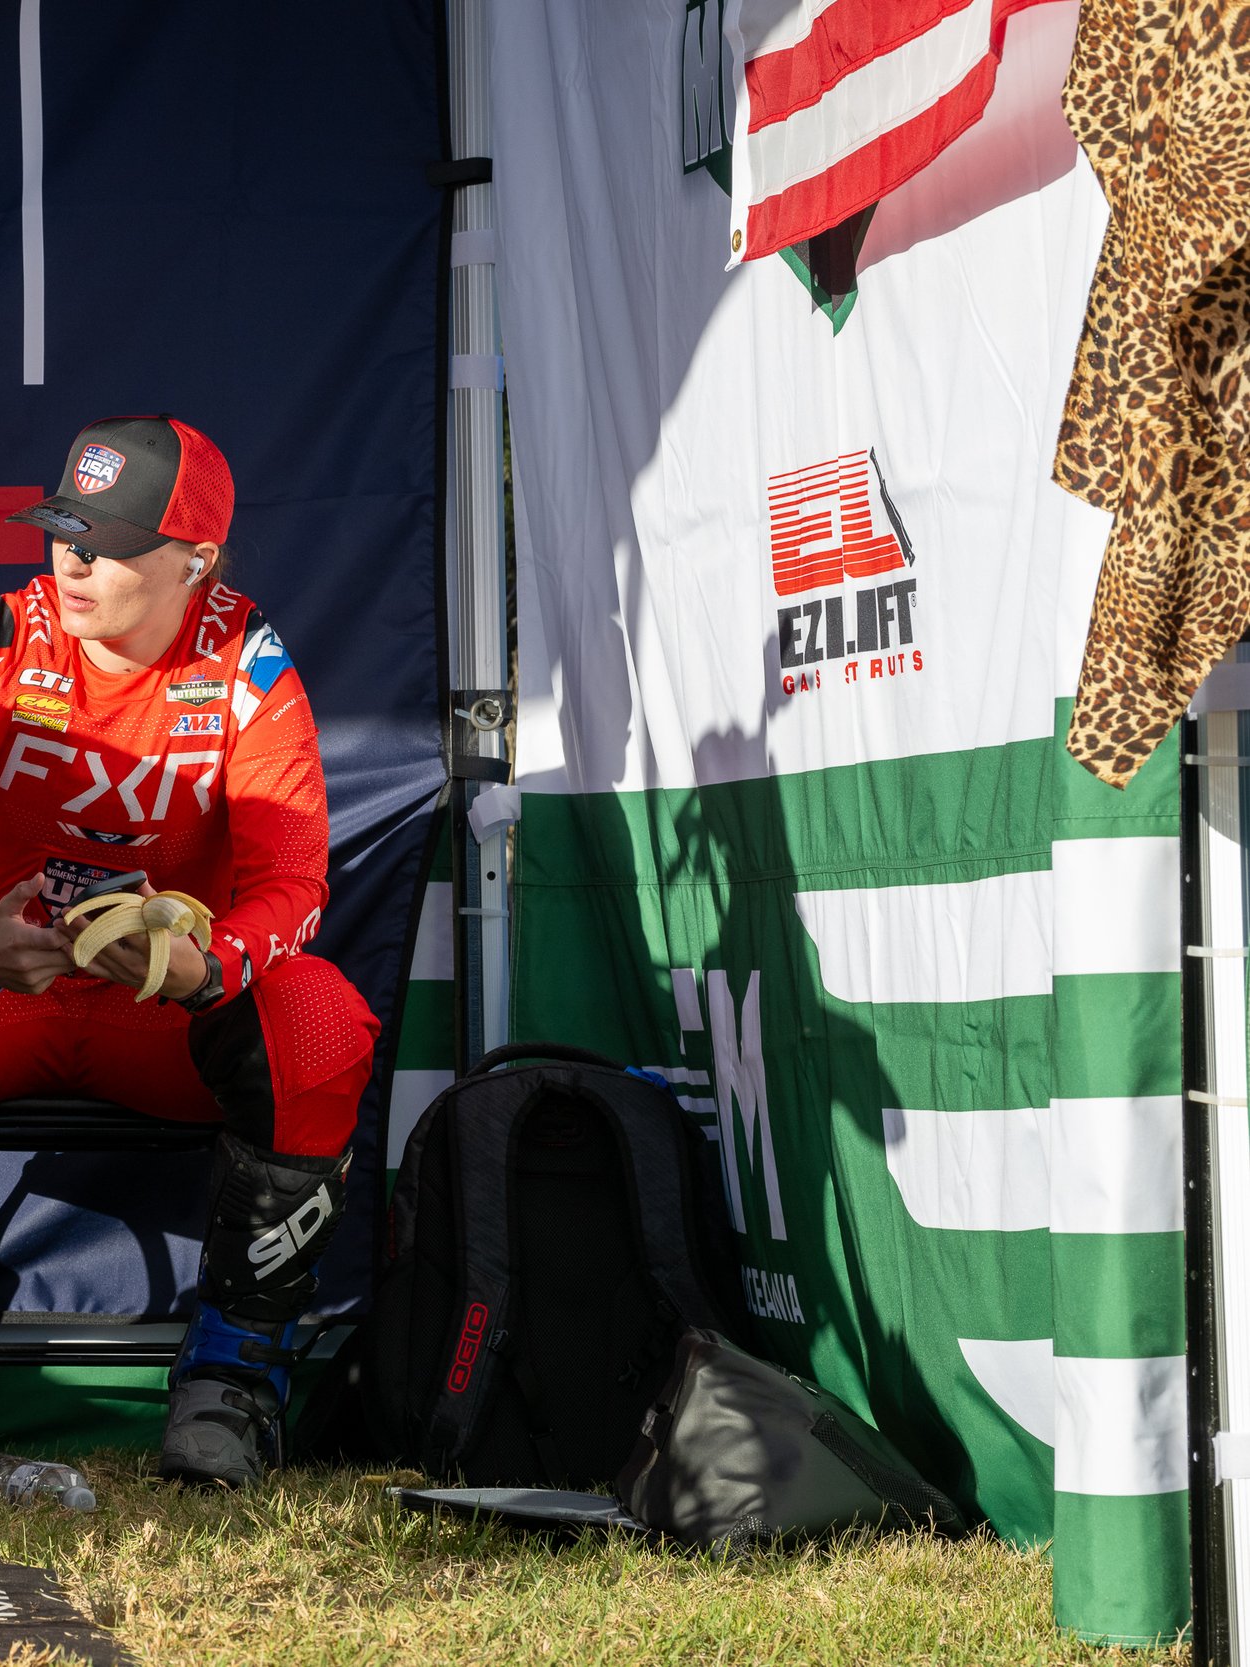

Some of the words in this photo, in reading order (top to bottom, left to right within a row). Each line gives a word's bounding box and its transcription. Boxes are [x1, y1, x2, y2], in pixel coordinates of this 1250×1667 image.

[78, 457, 114, 482] USA
[196, 582, 243, 663] FXR
[782, 669, 822, 695] GAS
[844, 650, 924, 685] STRUTS
[16, 695, 71, 712] FMF
[168, 687, 226, 700] MOTOCROSS
[13, 710, 67, 728] TRIANGLE
[172, 714, 221, 733] AMA
[46, 866, 77, 881] WOMENS
[247, 1182, 333, 1281] SIDI
[448, 1303, 488, 1392] OGIO
